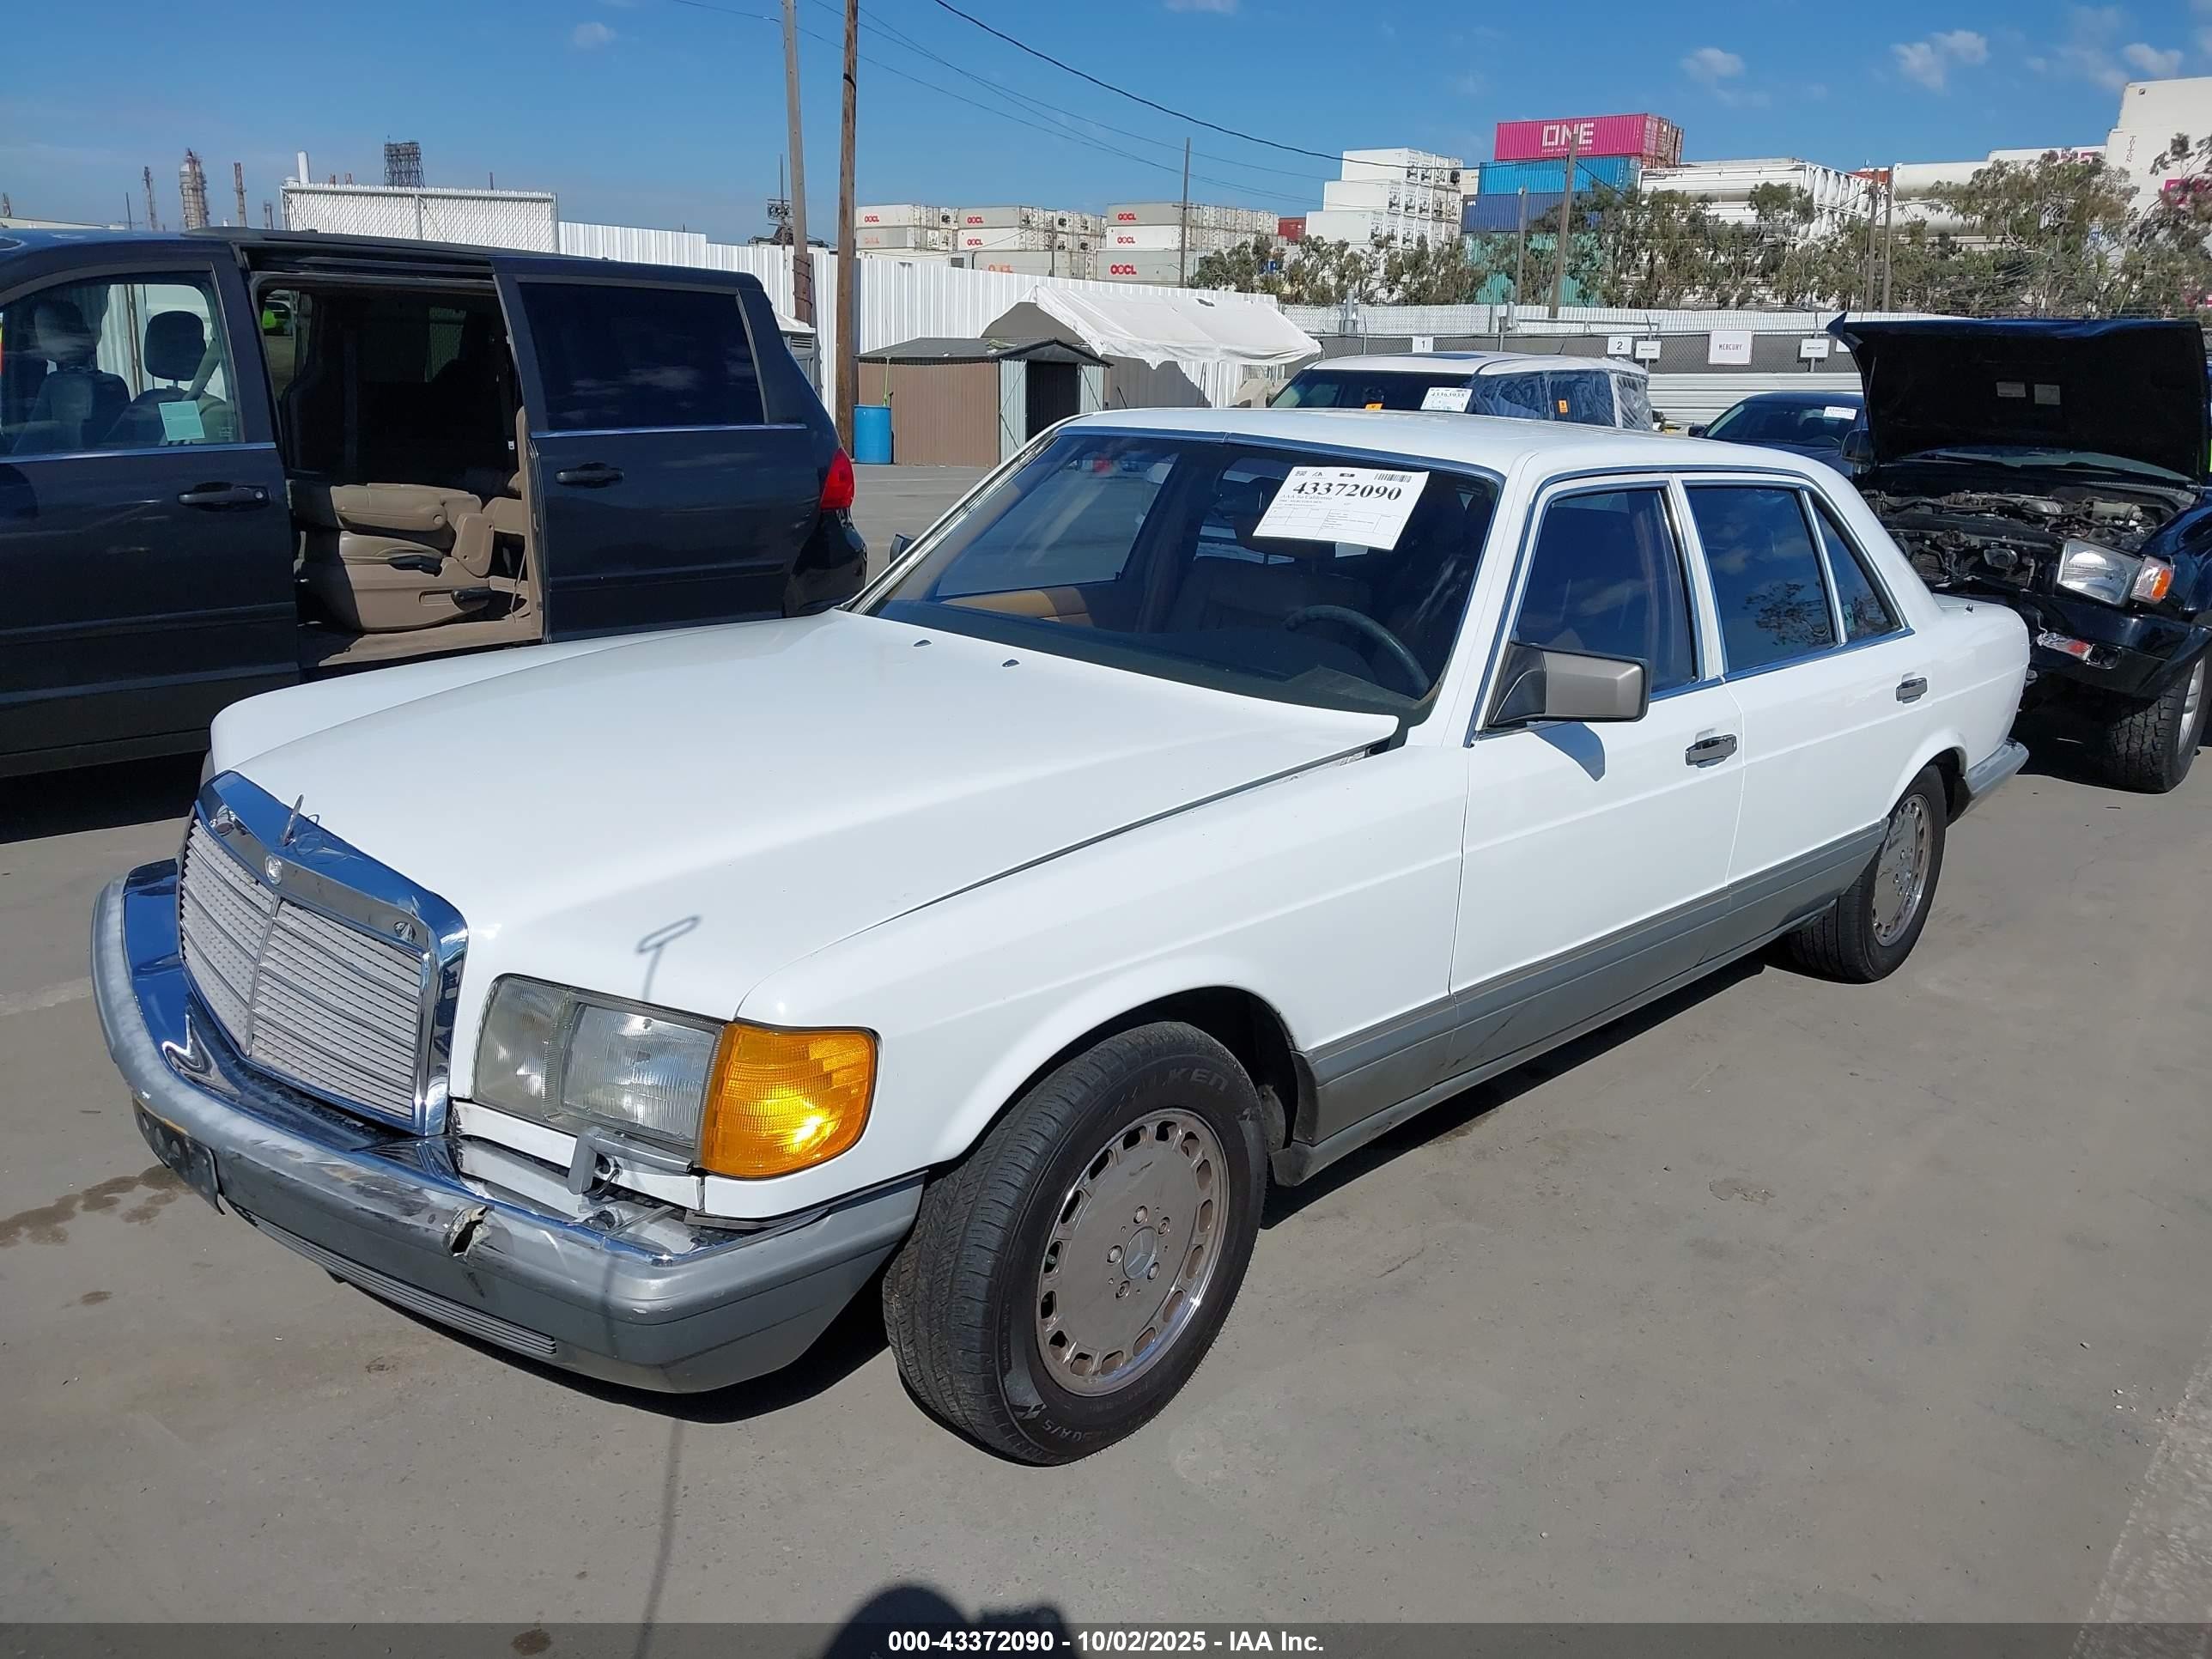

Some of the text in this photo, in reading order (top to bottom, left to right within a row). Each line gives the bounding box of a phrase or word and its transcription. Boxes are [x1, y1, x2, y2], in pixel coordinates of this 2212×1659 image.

[1541, 122, 1595, 146] ONE
[864, 215, 880, 223] OOCL
[1117, 212, 1137, 222] OOCL
[967, 238, 983, 246] OOCL
[1116, 235, 1136, 245] OOCL
[1110, 264, 1137, 276] OOCL
[1616, 341, 1623, 350] 2
[1718, 343, 1743, 351] MERCURY
[1293, 481, 1402, 501] 43372090
